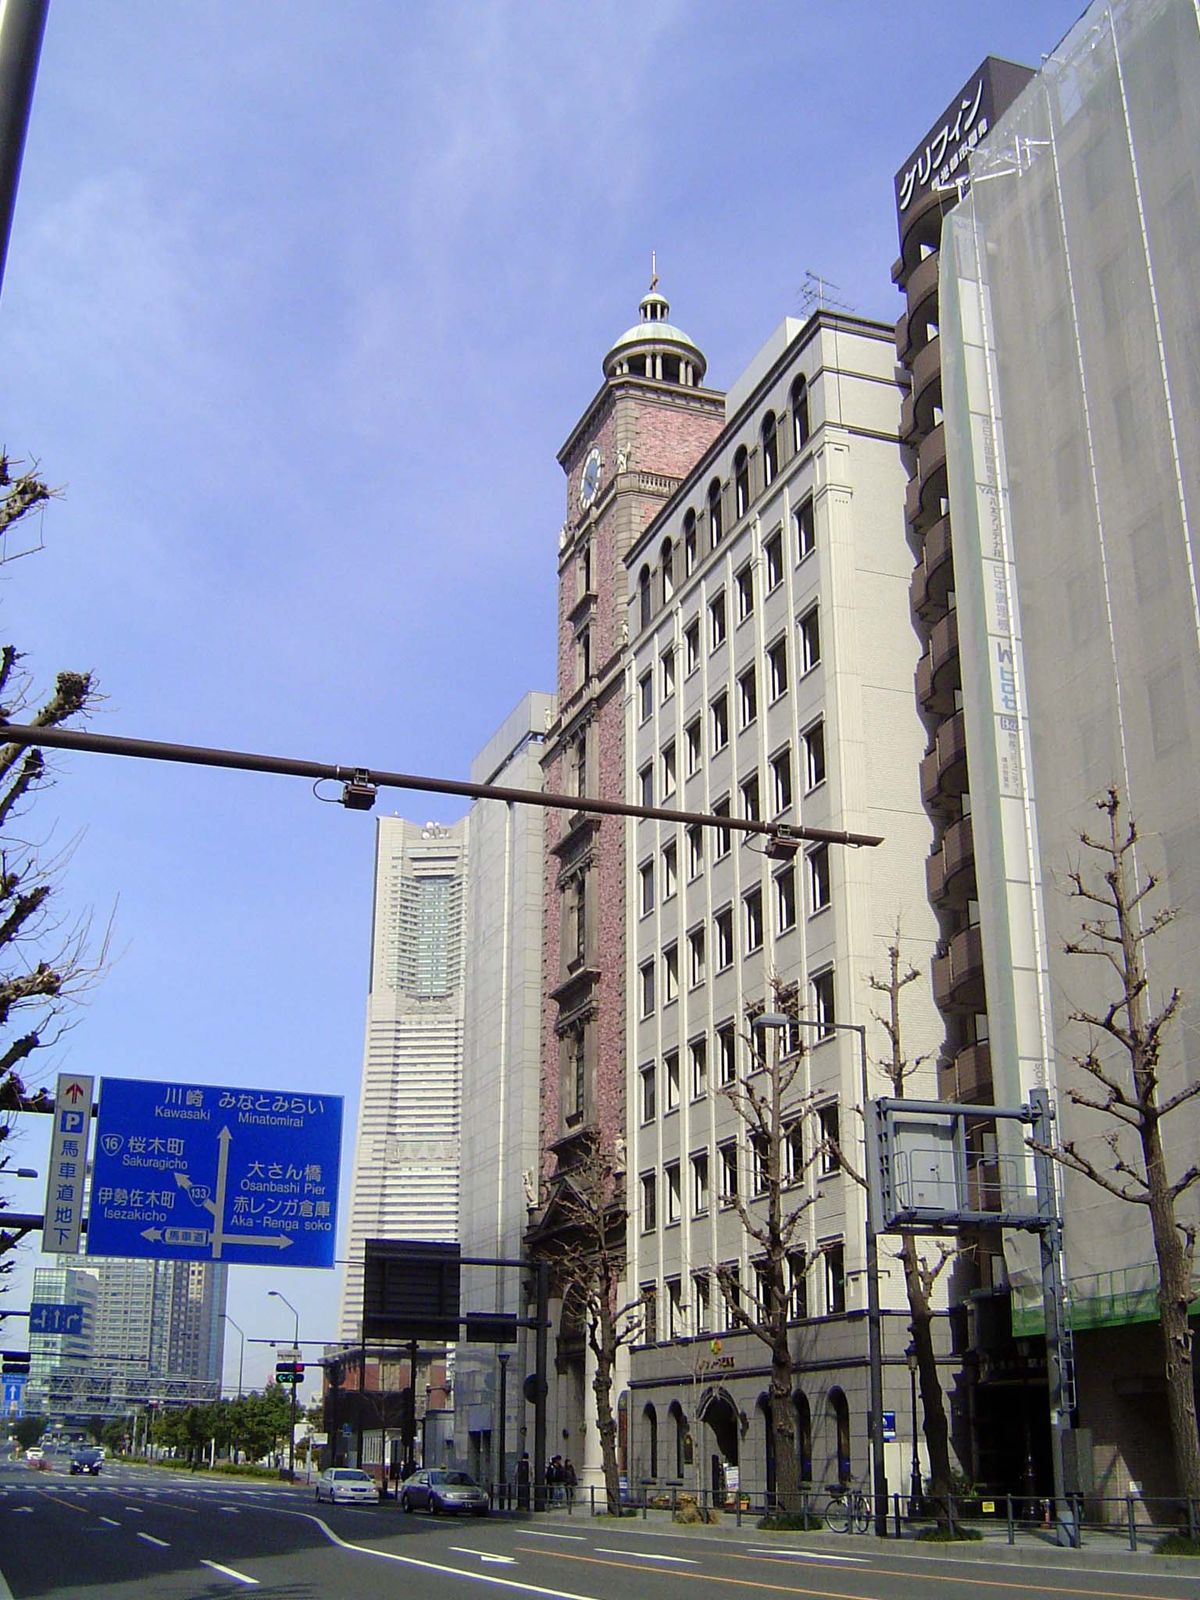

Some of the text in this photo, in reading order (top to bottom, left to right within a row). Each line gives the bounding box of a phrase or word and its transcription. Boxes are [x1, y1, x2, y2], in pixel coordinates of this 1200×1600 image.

[899, 79, 983, 210] グリフィン
[164, 1087, 324, 1115] 川崎 みなとみらい
[65, 1112, 81, 1131] P
[154, 1105, 304, 1128] Kawasaki Minatomirai
[105, 1137, 119, 1150] 16
[128, 1135, 185, 1156] 桜木町
[122, 1154, 188, 1171] Sakuragicho
[247, 1160, 322, 1183] 大さん橋
[53, 1139, 80, 1246] 馬車道地下
[191, 1188, 207, 1199] 133
[240, 1179, 326, 1195] Osanbashi Pier
[98, 1187, 176, 1209] 伊勢佐木町
[233, 1195, 331, 1219] 赤レンガ倉庫
[103, 1207, 167, 1222] Isezakicho
[304, 1220, 332, 1232] soko
